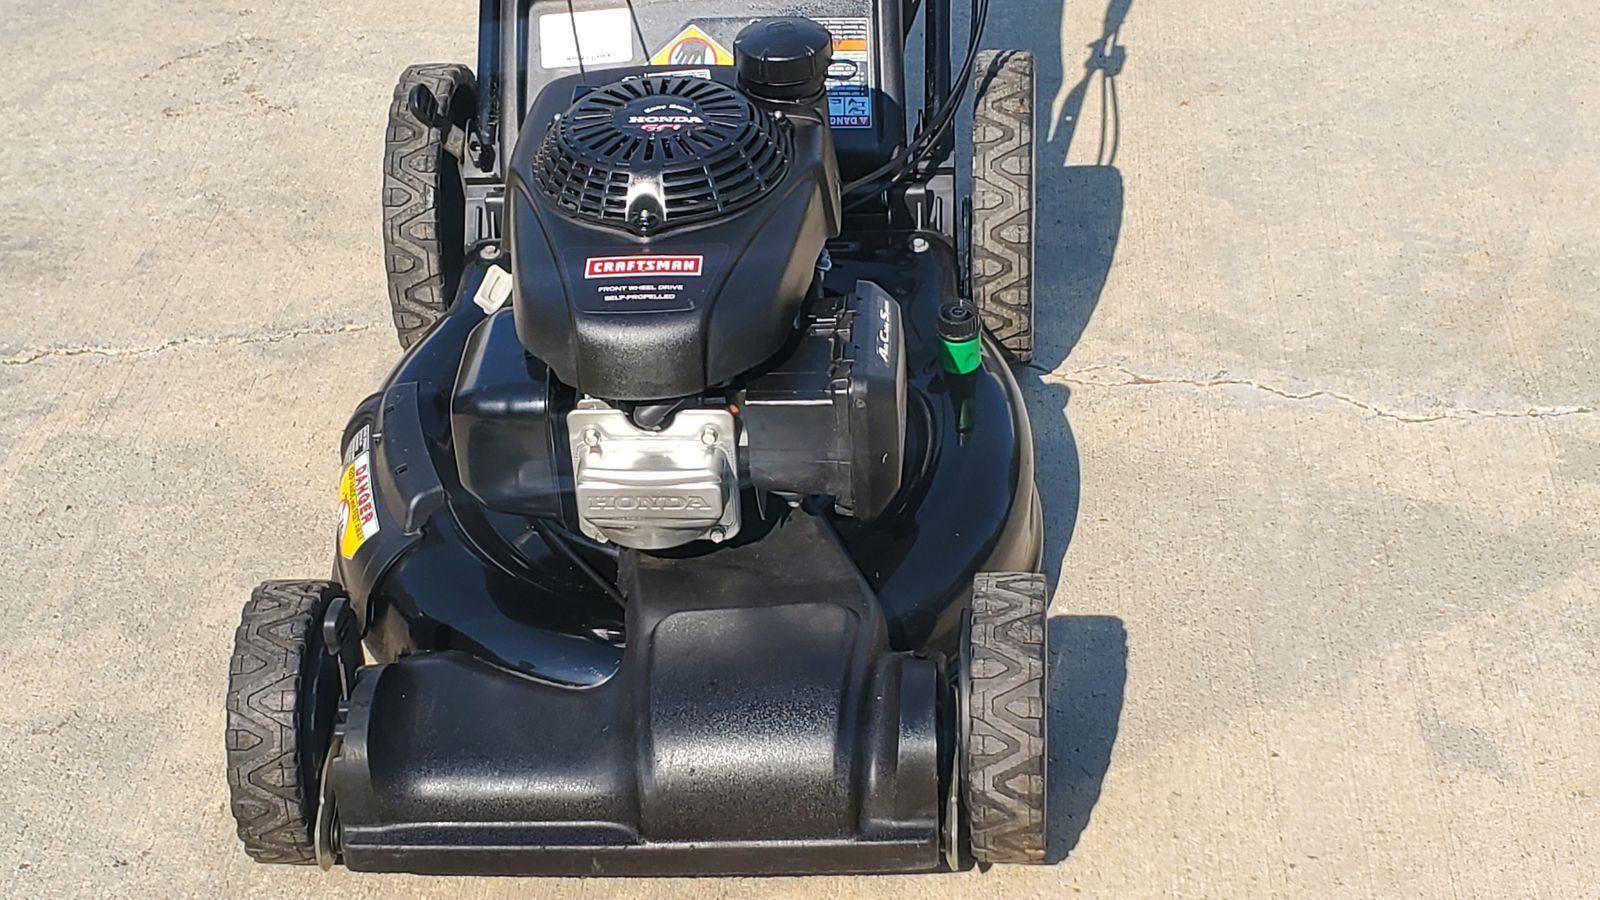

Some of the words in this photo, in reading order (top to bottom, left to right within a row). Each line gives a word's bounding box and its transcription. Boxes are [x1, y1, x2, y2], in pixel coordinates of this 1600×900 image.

[830, 117, 858, 125] DANG
[593, 260, 695, 273] CRAFTSMAN
[604, 293, 676, 302] SELF-PROPELLED
[355, 464, 373, 525] DANGER
[587, 496, 712, 510] HONDA
